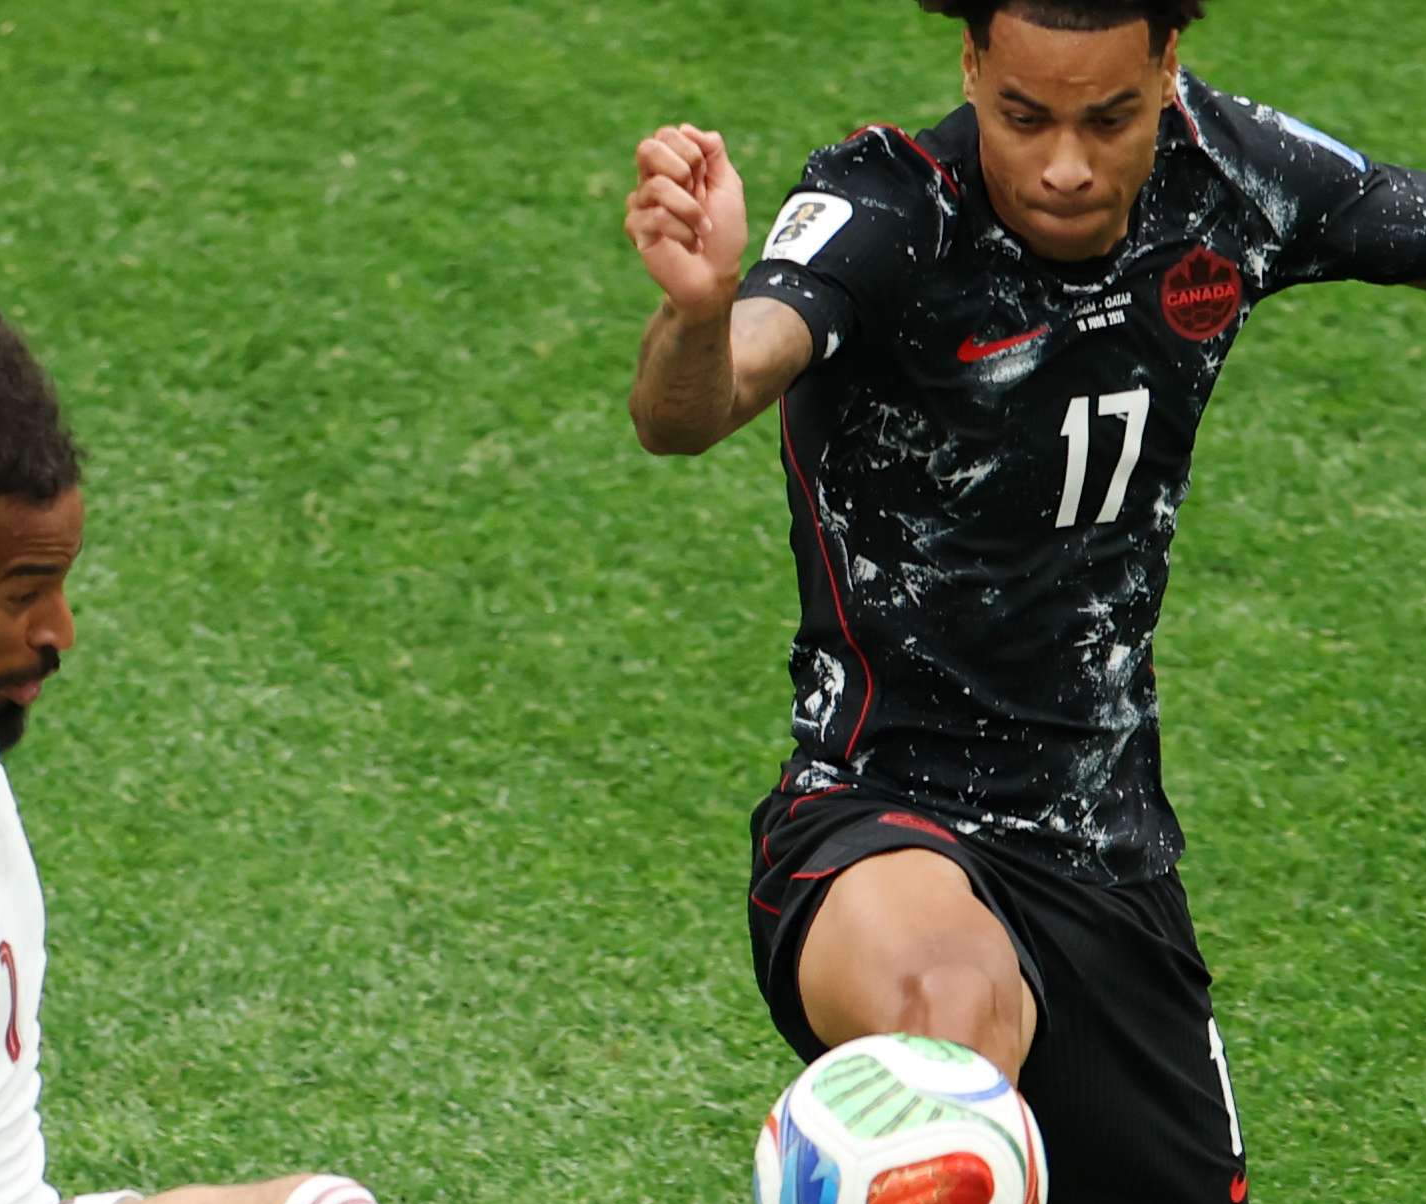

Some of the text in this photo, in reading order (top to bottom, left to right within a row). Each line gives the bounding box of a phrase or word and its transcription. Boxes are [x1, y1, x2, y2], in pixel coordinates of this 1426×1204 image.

[1104, 291, 1132, 309] QATAR
[1167, 285, 1235, 306] CANADA
[1055, 388, 1150, 528] 17
